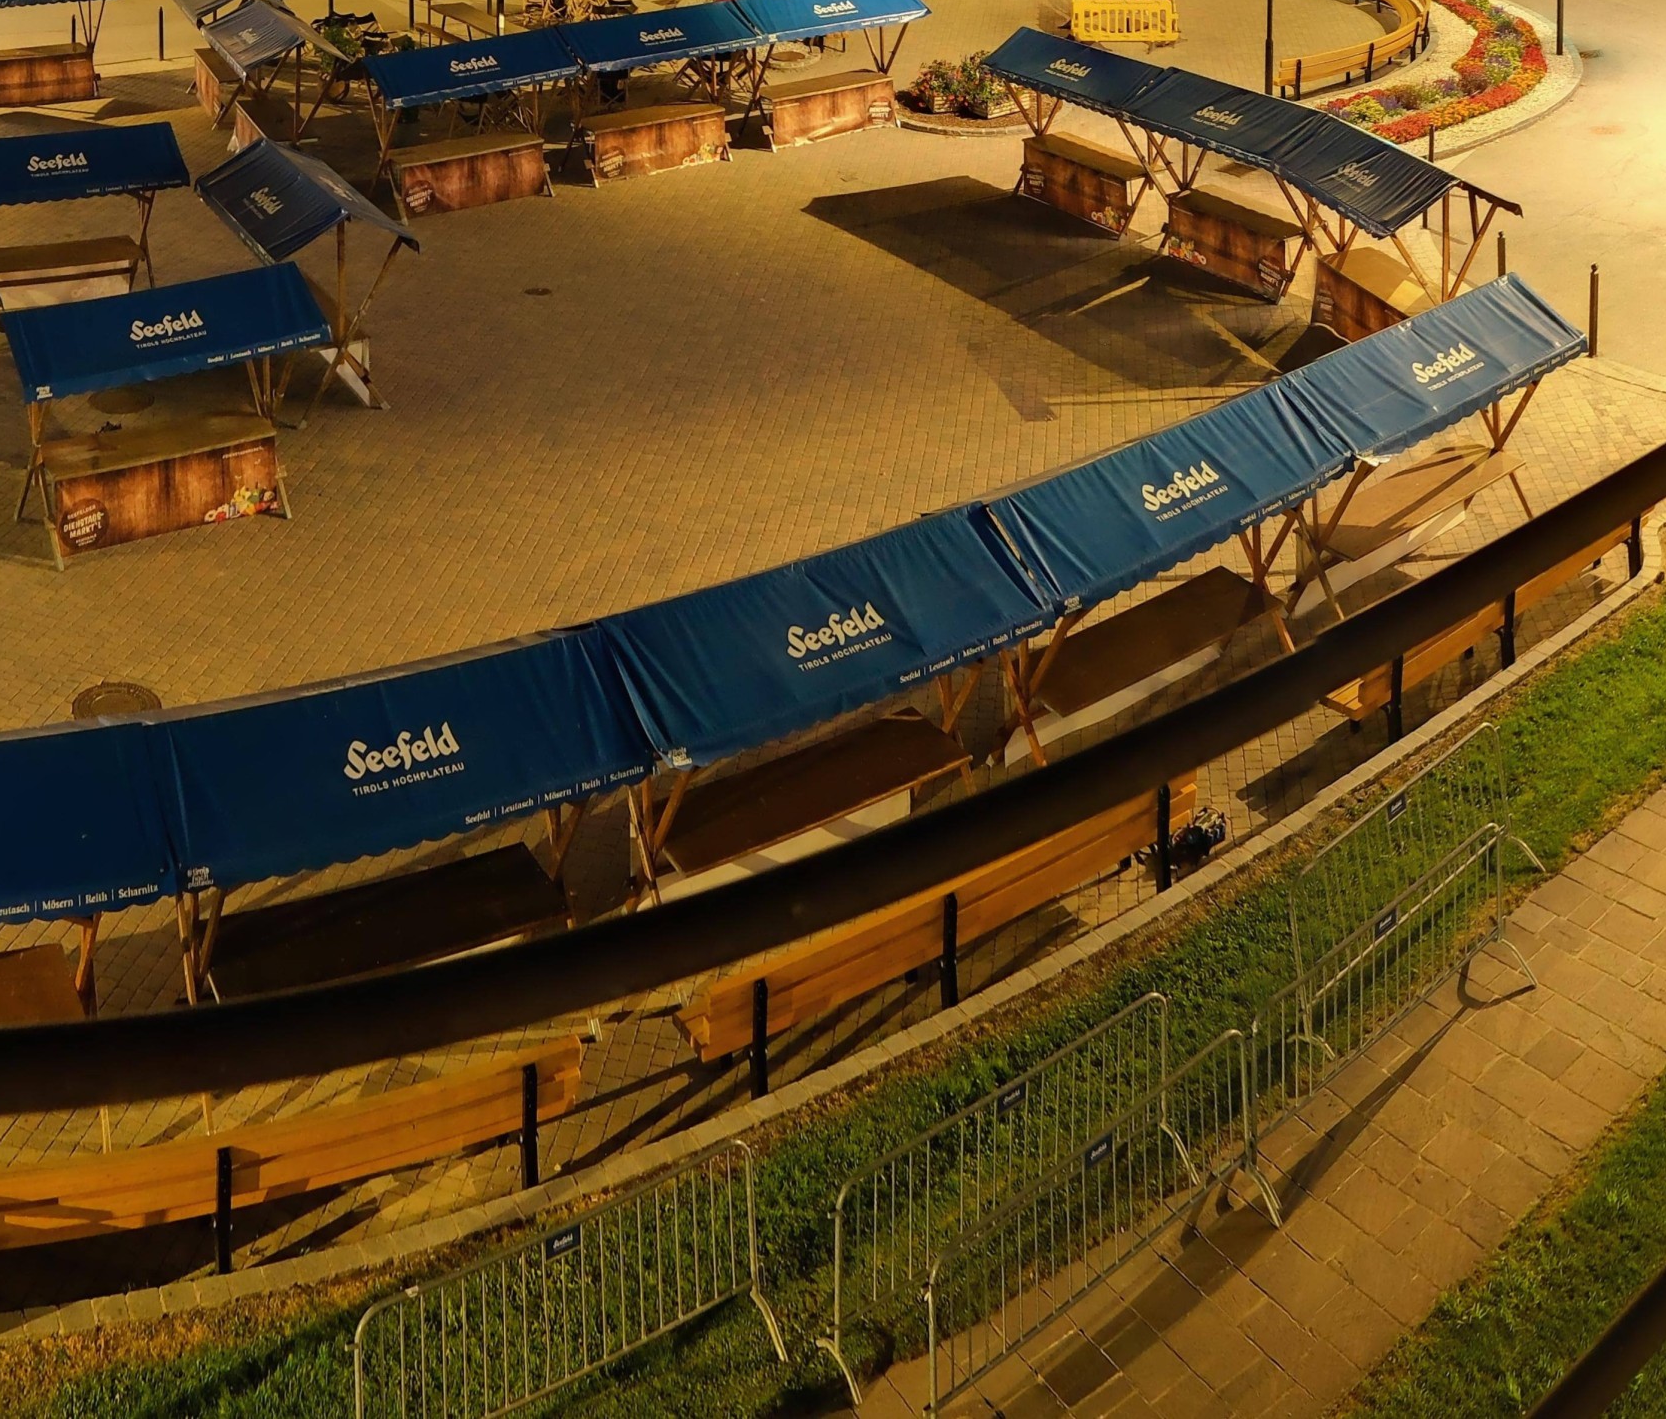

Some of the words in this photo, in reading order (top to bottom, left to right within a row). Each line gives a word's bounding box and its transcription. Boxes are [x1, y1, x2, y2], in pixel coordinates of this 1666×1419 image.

[813, 0, 856, 15] Seefeld
[639, 27, 684, 43] Seefeld
[450, 55, 498, 72] Seefeld
[1049, 58, 1093, 78] Seefeld
[1196, 105, 1244, 126] Seefeld
[27, 152, 88, 172] Seefeld
[129, 310, 204, 342] Seefeld
[1412, 342, 1477, 384] Seefeld
[1142, 461, 1220, 512] Seefeld
[787, 601, 885, 659] Seefeld
[798, 655, 831, 672] TIROLS
[831, 633, 892, 660] HOCHPLATEAU
[344, 722, 460, 780] Seefeld
[353, 780, 390, 796] TIROLS
[392, 762, 465, 787] HOCHPLATEAU
[465, 810, 491, 825] Seefeld
[500, 797, 535, 816] Leutasch
[544, 788, 572, 804] Mösern
[581, 780, 601, 793] Reith
[609, 765, 645, 784] Scharnitz
[42, 896, 74, 911] Mösern
[85, 892, 108, 904] Reith
[118, 884, 160, 901] Scharnitz
